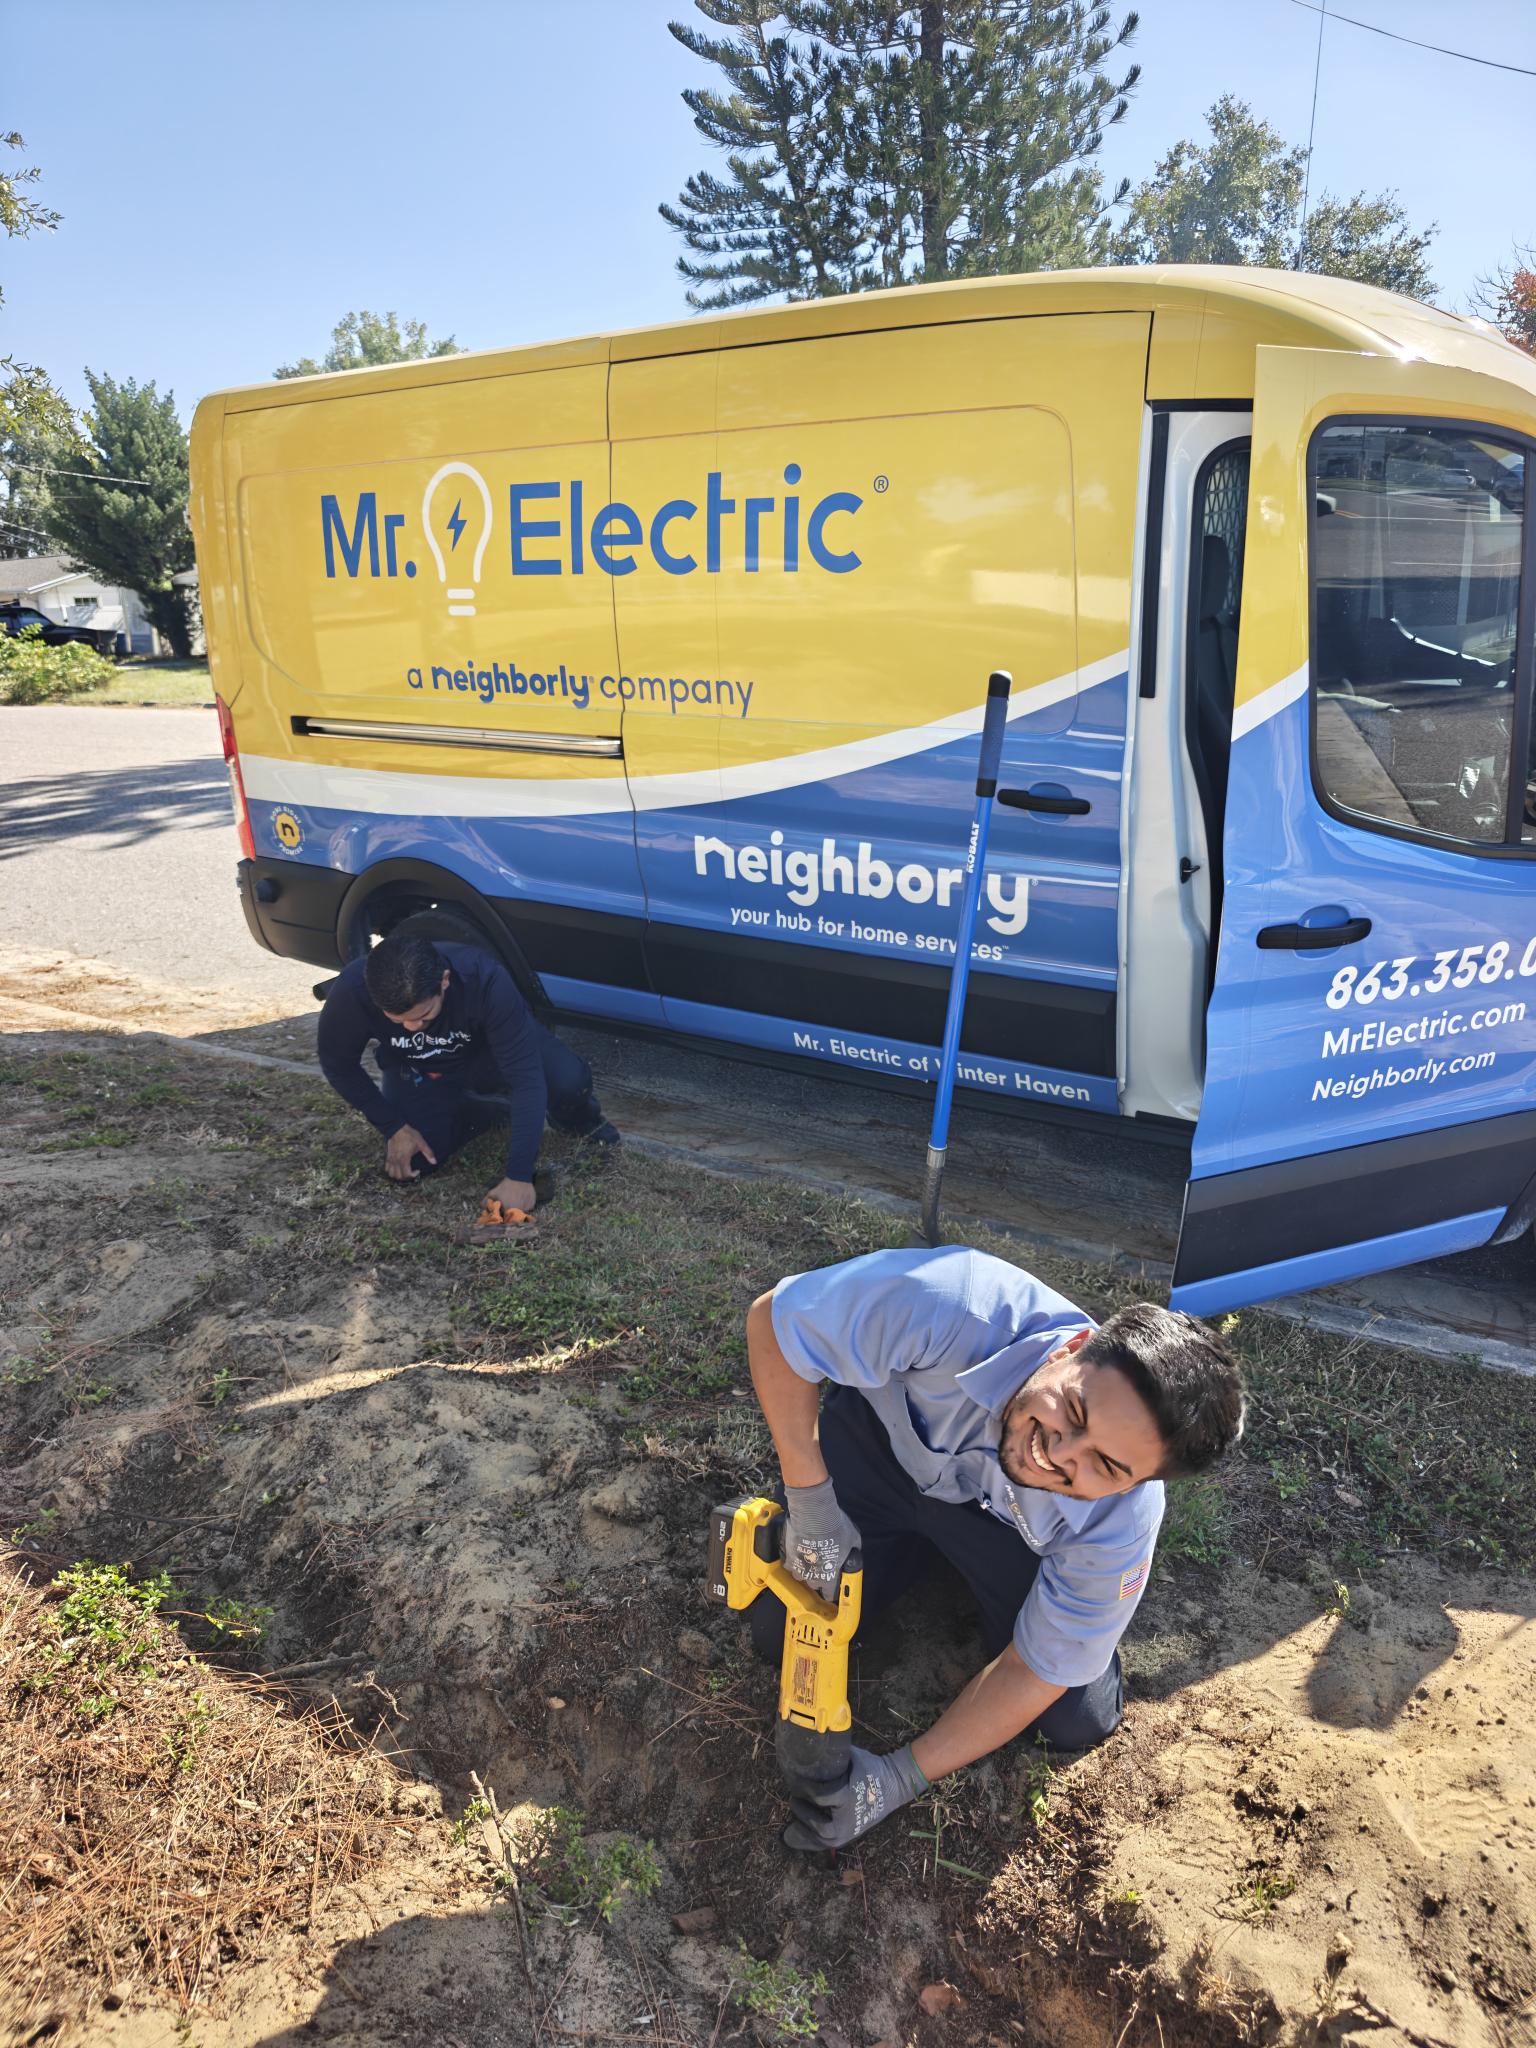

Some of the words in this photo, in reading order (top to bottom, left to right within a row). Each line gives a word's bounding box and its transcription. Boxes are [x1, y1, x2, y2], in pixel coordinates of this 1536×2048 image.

[320, 492, 417, 578] Mr.
[407, 668, 423, 689] a
[600, 674, 754, 719] company
[966, 820, 980, 874] KOBALT
[731, 907, 770, 926] your
[776, 909, 812, 932] hub
[817, 916, 845, 936] for
[851, 920, 908, 946] home
[391, 1036, 412, 1048] Mr.
[1321, 1002, 1526, 1059] MrElectric.com
[793, 1032, 825, 1052] Mr.
[830, 1039, 902, 1067] Electric
[909, 1056, 929, 1072] of
[935, 1058, 1007, 1085] inter
[1014, 1073, 1091, 1101] Haven
[1312, 1051, 1496, 1101] Neighborly.com
[717, 1584, 726, 1596] 8
